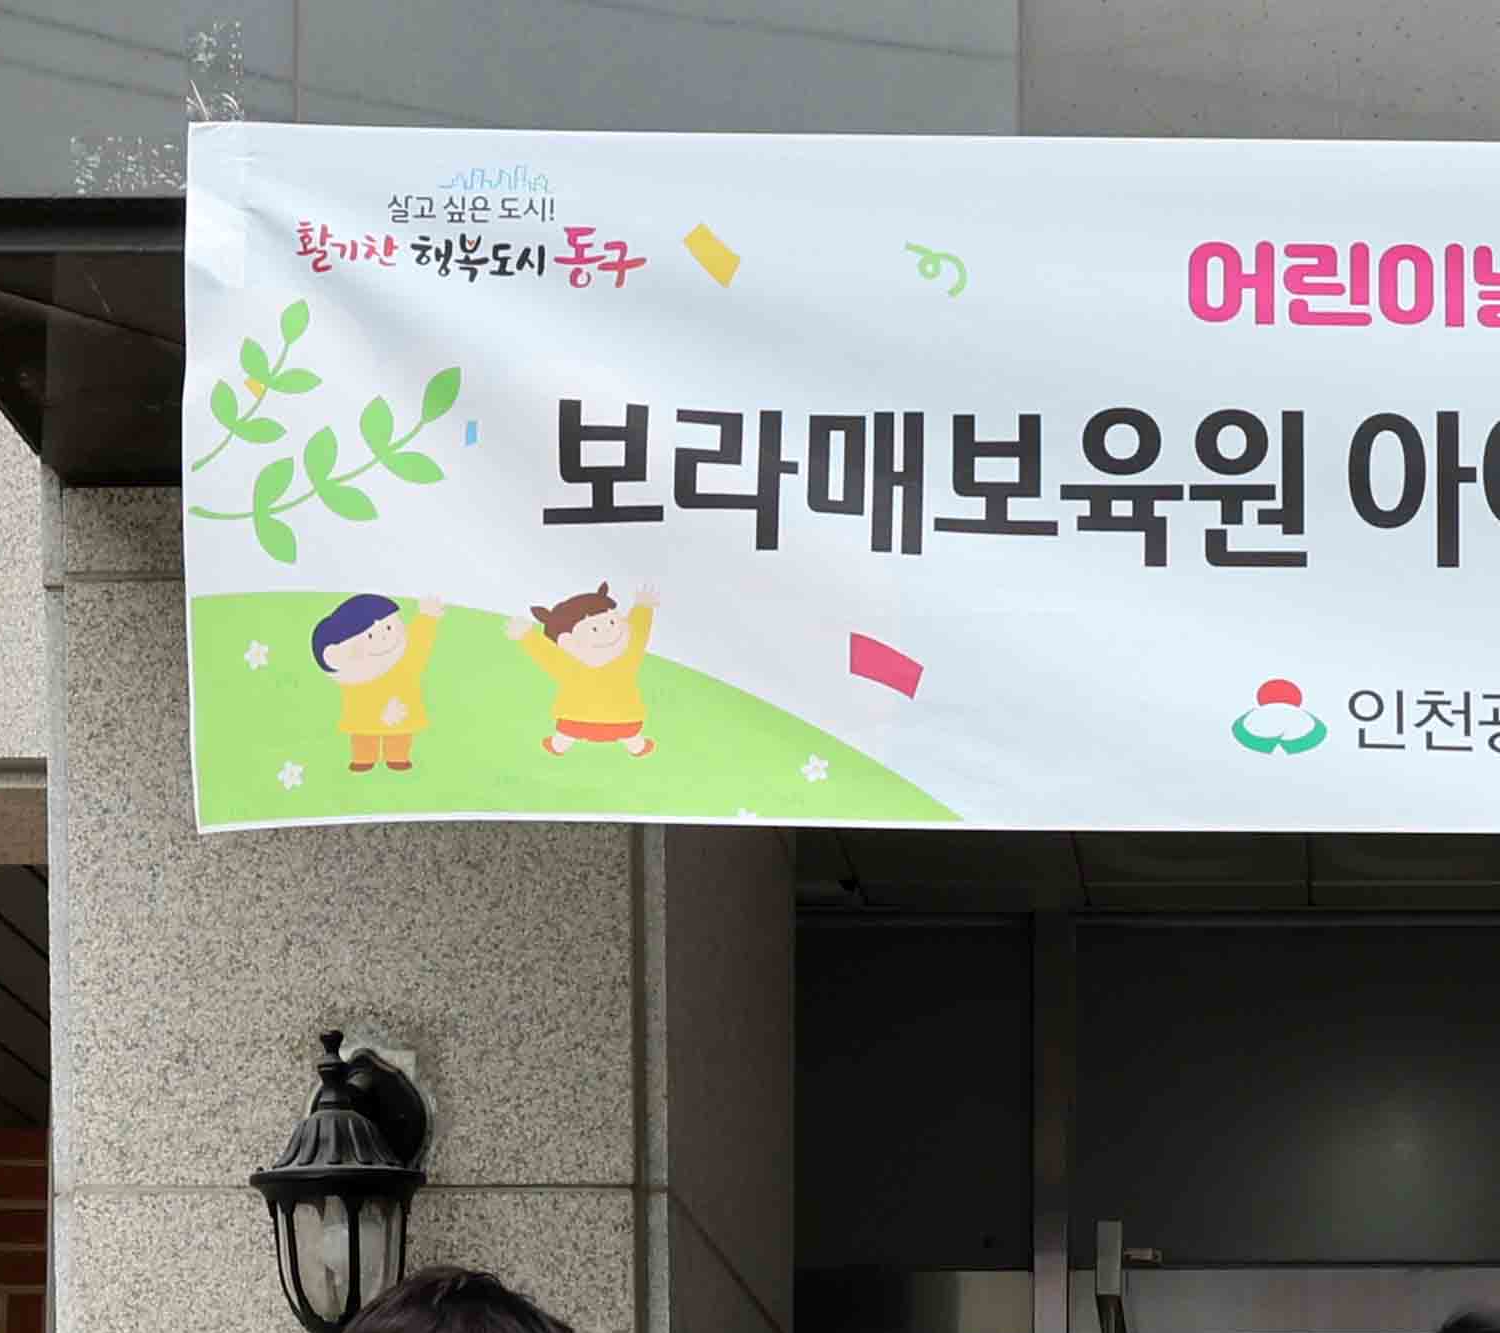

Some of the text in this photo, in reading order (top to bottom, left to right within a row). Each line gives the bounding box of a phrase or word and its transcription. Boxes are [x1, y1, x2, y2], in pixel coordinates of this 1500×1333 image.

[388, 196, 554, 223] 살고 싶은 도시!
[295, 221, 647, 288] 활기찬 행복도시 동구
[543, 400, 1307, 567] 보라매보육원
